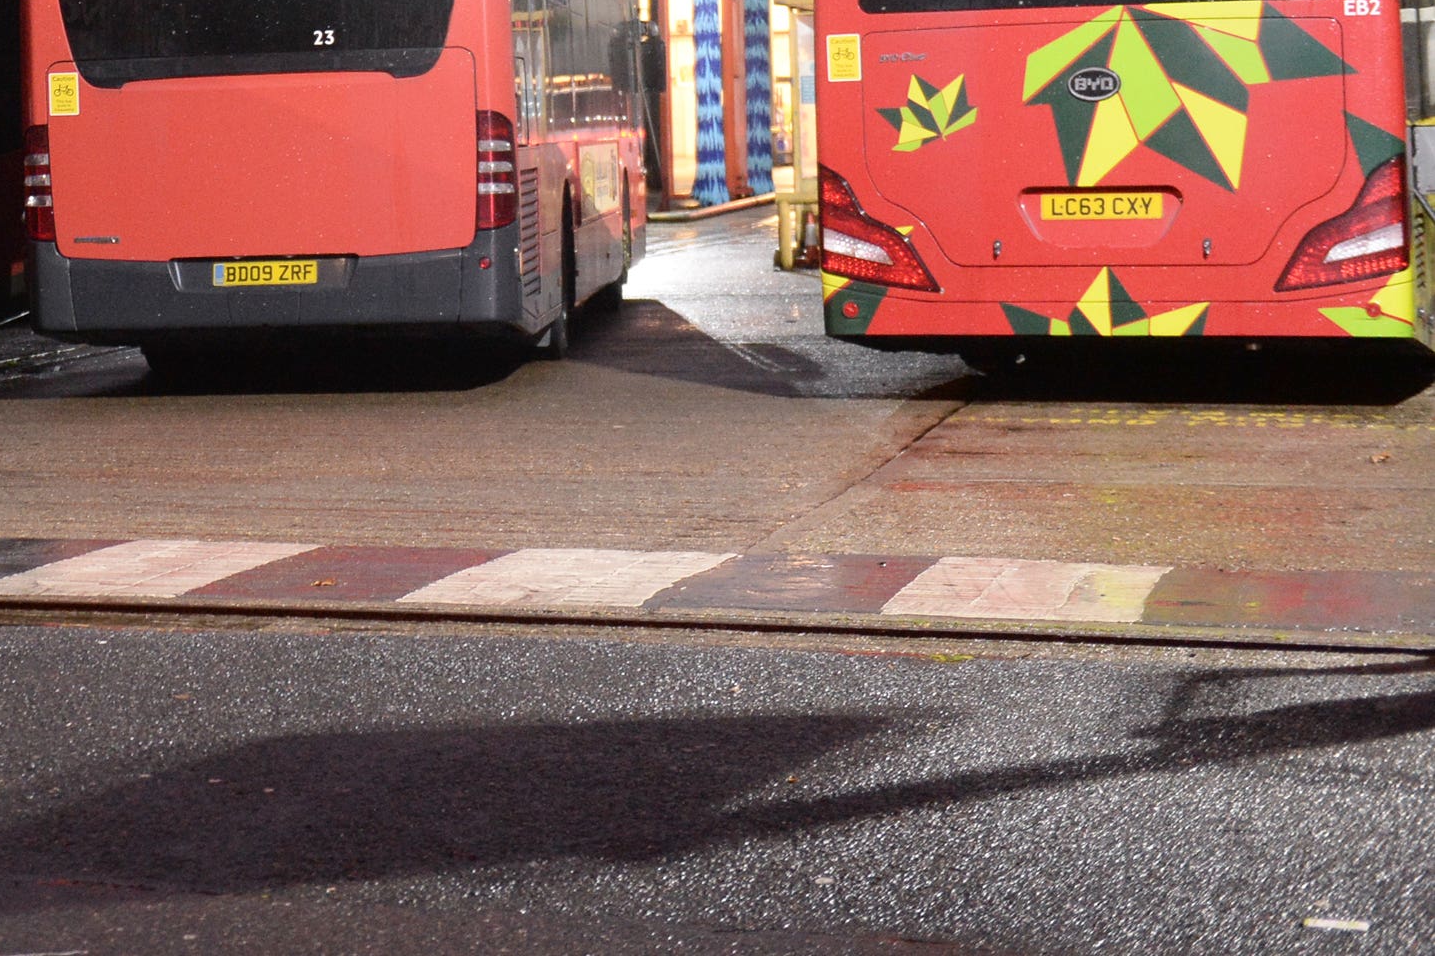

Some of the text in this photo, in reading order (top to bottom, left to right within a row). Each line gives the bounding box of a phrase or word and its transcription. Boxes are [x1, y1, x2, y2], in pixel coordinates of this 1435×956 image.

[313, 29, 335, 45] 23
[1074, 77, 1113, 91] BYD
[1052, 197, 1152, 216] LC63 CXY
[226, 264, 314, 283] BD09 ZRF
